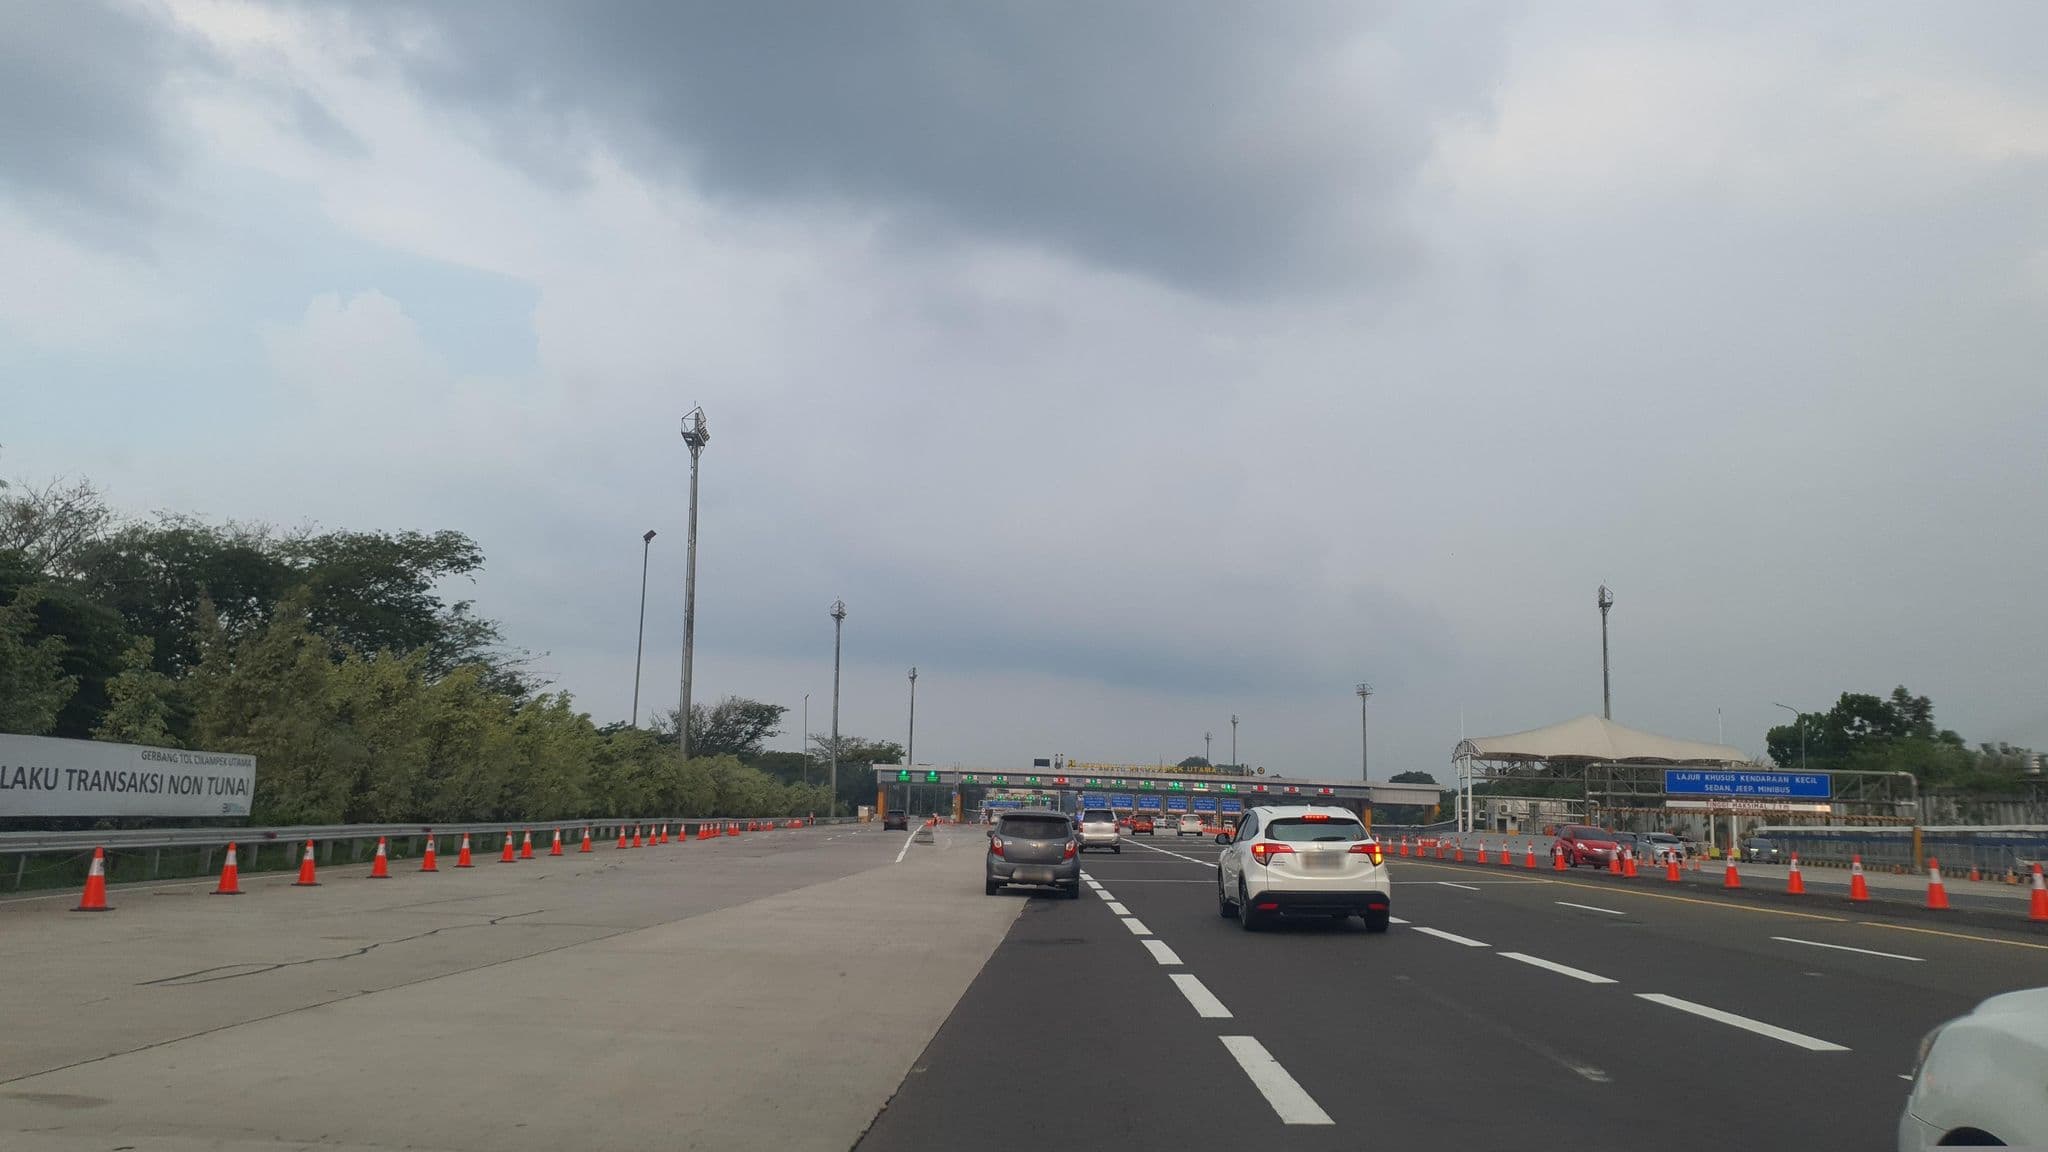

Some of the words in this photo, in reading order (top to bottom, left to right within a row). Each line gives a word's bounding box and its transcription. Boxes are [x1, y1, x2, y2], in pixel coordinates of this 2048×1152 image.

[141, 750, 178, 763] GERBANG
[179, 754, 194, 764] TOL
[0, 765, 59, 791] LAKU
[65, 768, 164, 795] TRANSAKSI
[168, 774, 204, 796] NON
[207, 776, 250, 797] TUNAI
[1676, 773, 1700, 781] LAJUR
[1705, 774, 1736, 782] KHUSUS
[1740, 775, 1790, 784] KENDARAAN
[1758, 786, 1791, 794] MINIBUS
